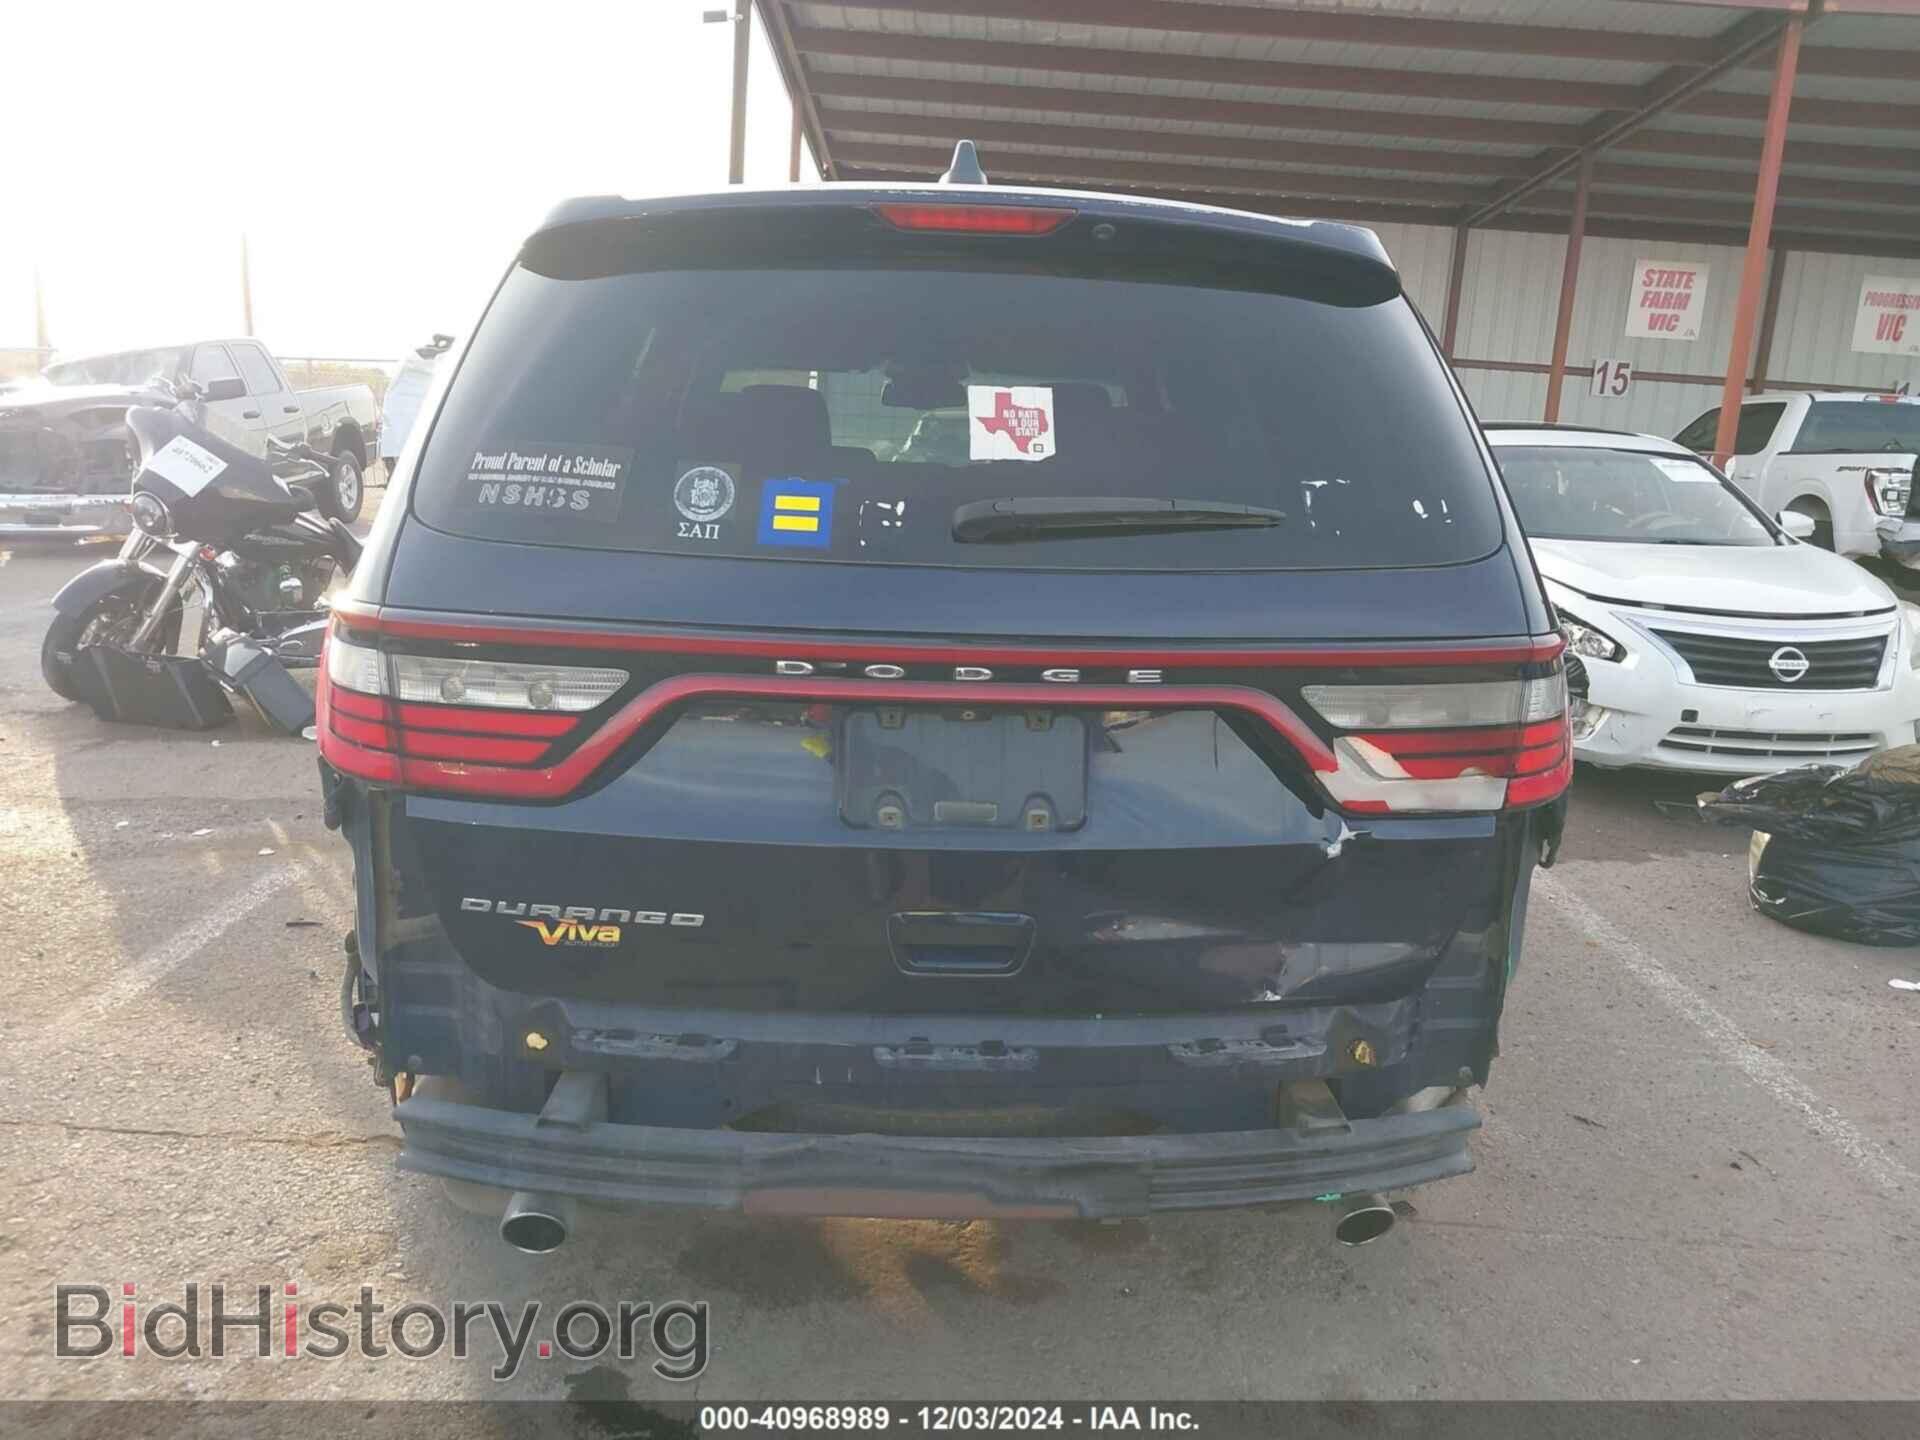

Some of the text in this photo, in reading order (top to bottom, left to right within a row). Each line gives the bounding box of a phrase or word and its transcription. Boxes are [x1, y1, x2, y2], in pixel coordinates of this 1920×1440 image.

[1642, 269, 1696, 289] STATE
[1640, 290, 1691, 311] FARM
[1648, 312, 1680, 332] VIC
[1876, 313, 1906, 343] VIC
[1597, 361, 1630, 395] 15
[471, 452, 621, 478] Proud Parent of a Scholar
[776, 660, 1163, 683] DODGE
[461, 897, 704, 926] DURANGO
[514, 917, 620, 945] Viva
